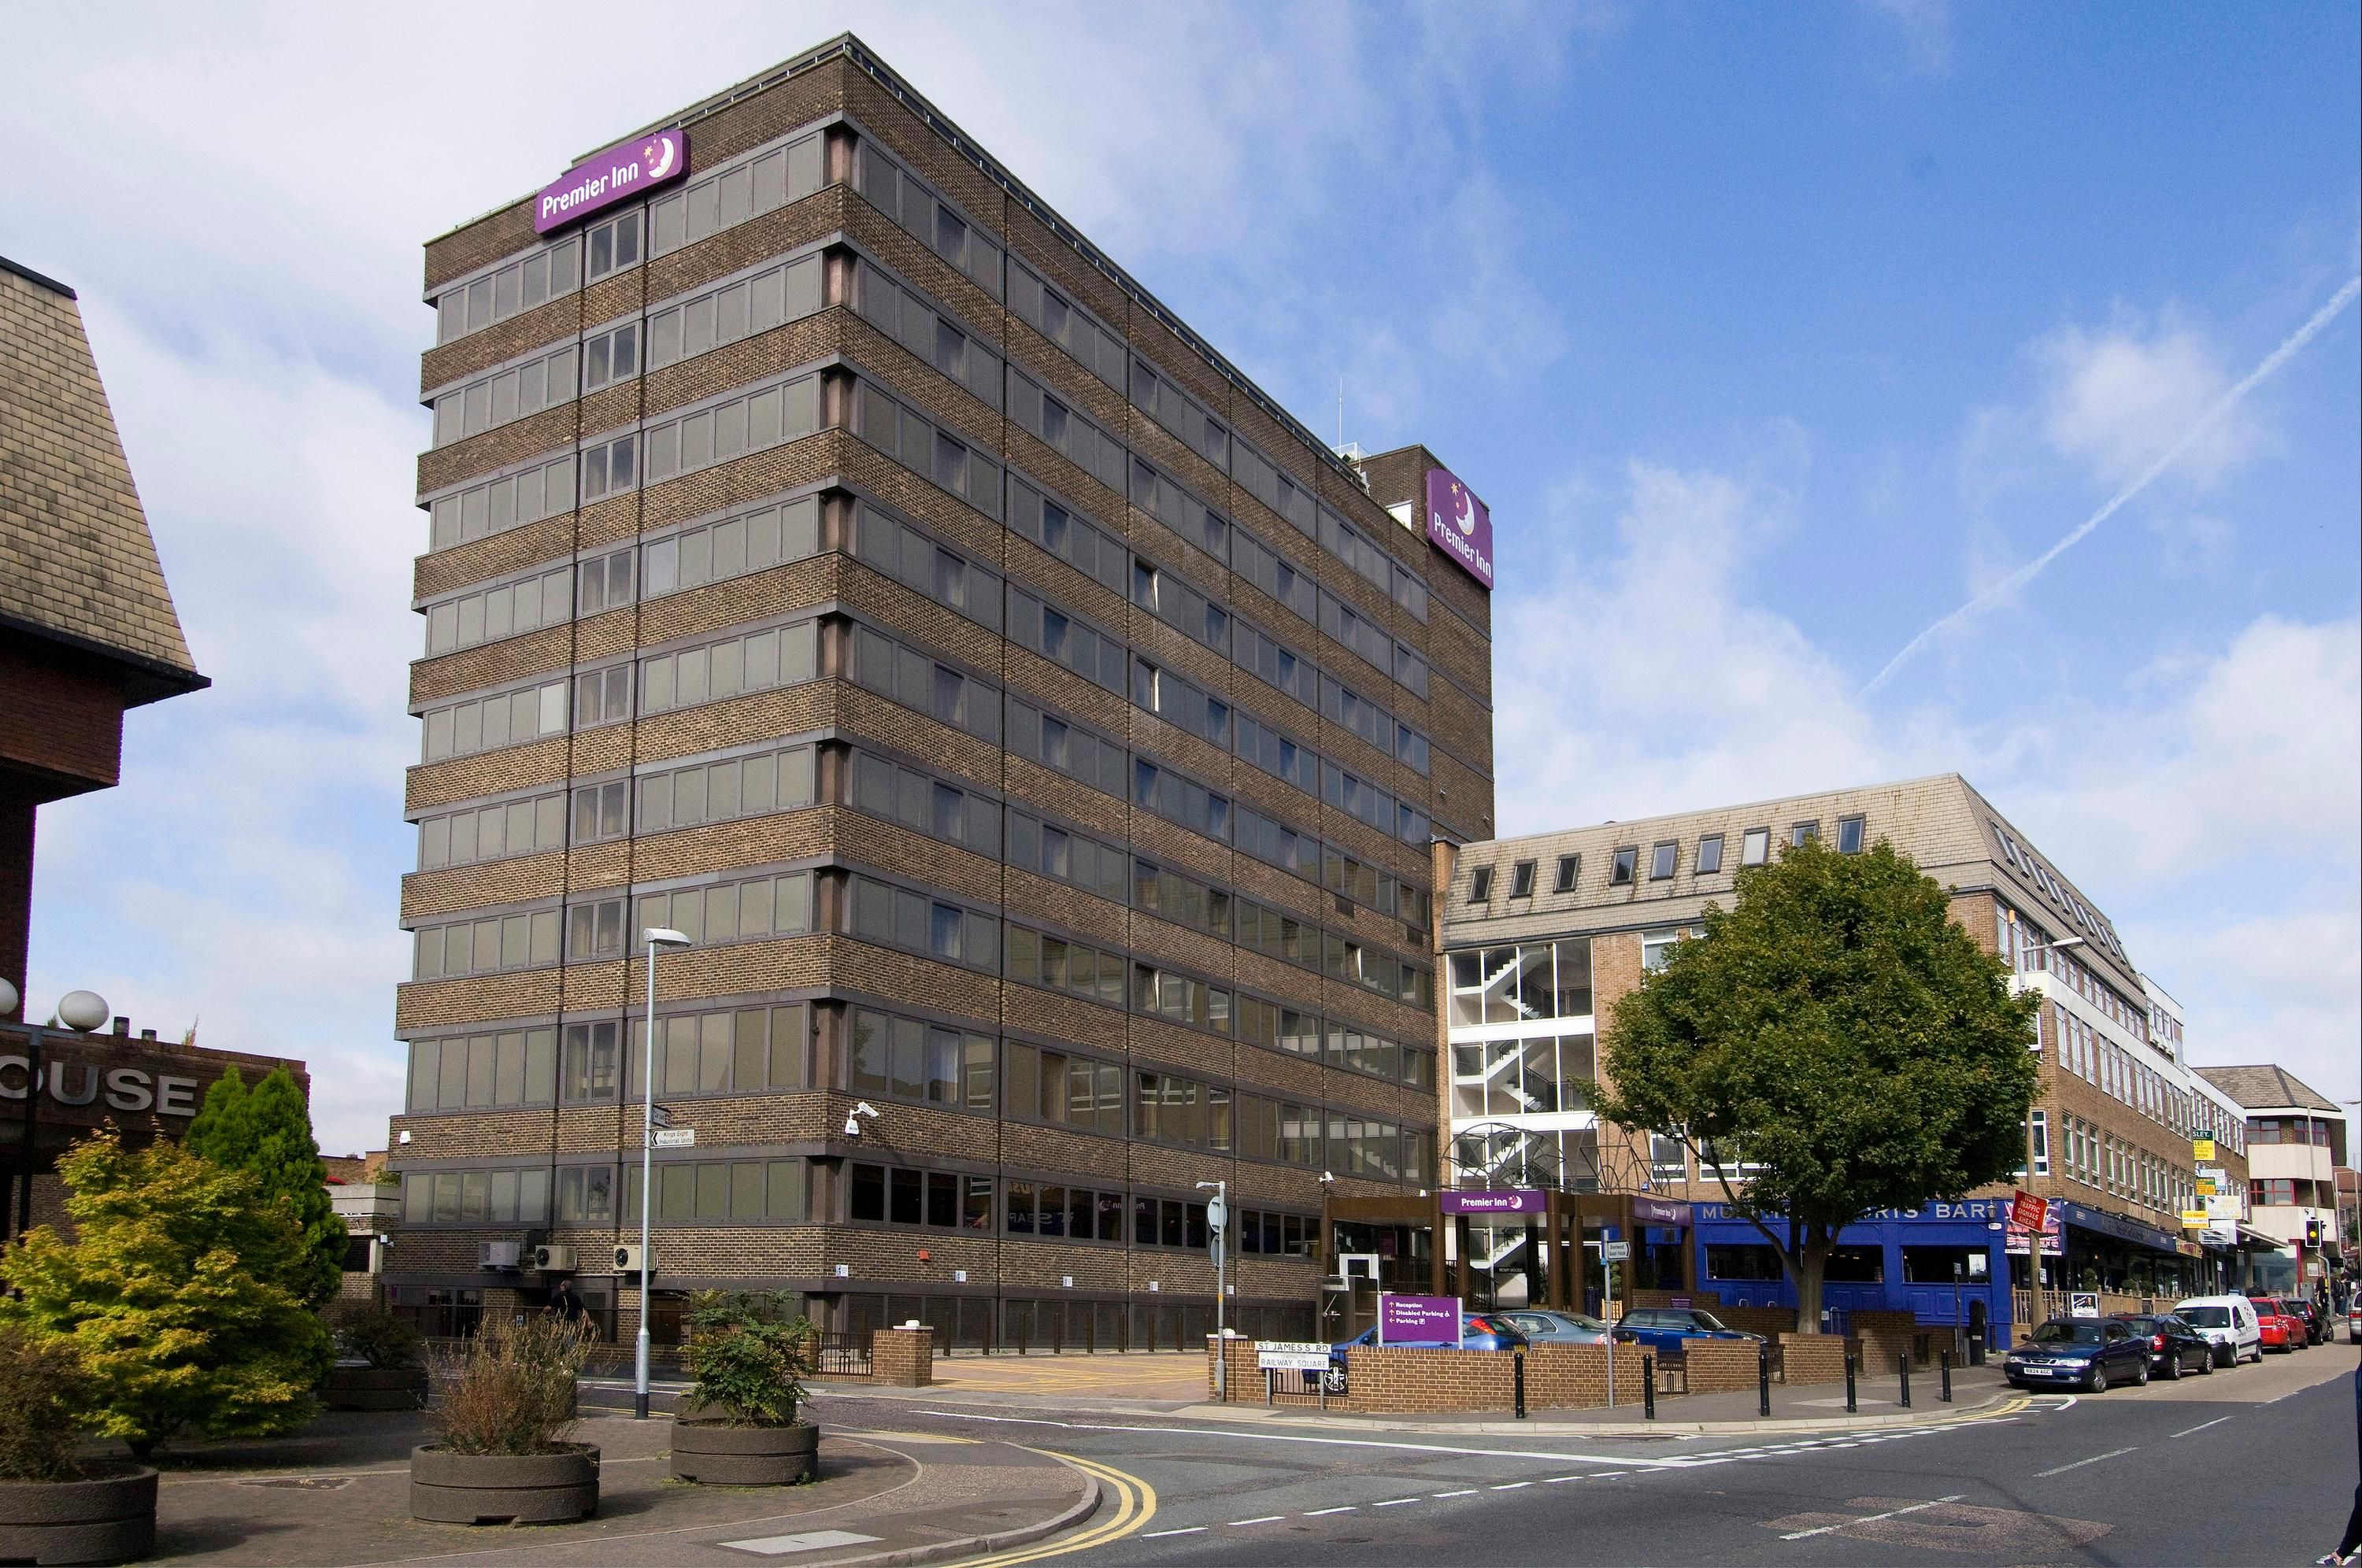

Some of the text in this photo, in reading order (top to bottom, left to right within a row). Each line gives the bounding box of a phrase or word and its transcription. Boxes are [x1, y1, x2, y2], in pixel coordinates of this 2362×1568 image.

[542, 162, 639, 219] Premier Inn
[1434, 512, 1492, 578] Premier Inn
[1461, 1197, 1508, 1207] Premier Inn
[2020, 1201, 2041, 1213] TRAFFIC
[1935, 1204, 1986, 1219] BAR
[2017, 1207, 2039, 1221] SIGNALS
[2018, 1216, 2036, 1227] AHEAD
[1261, 1358, 1327, 1368] RAILWAY SQUARE
